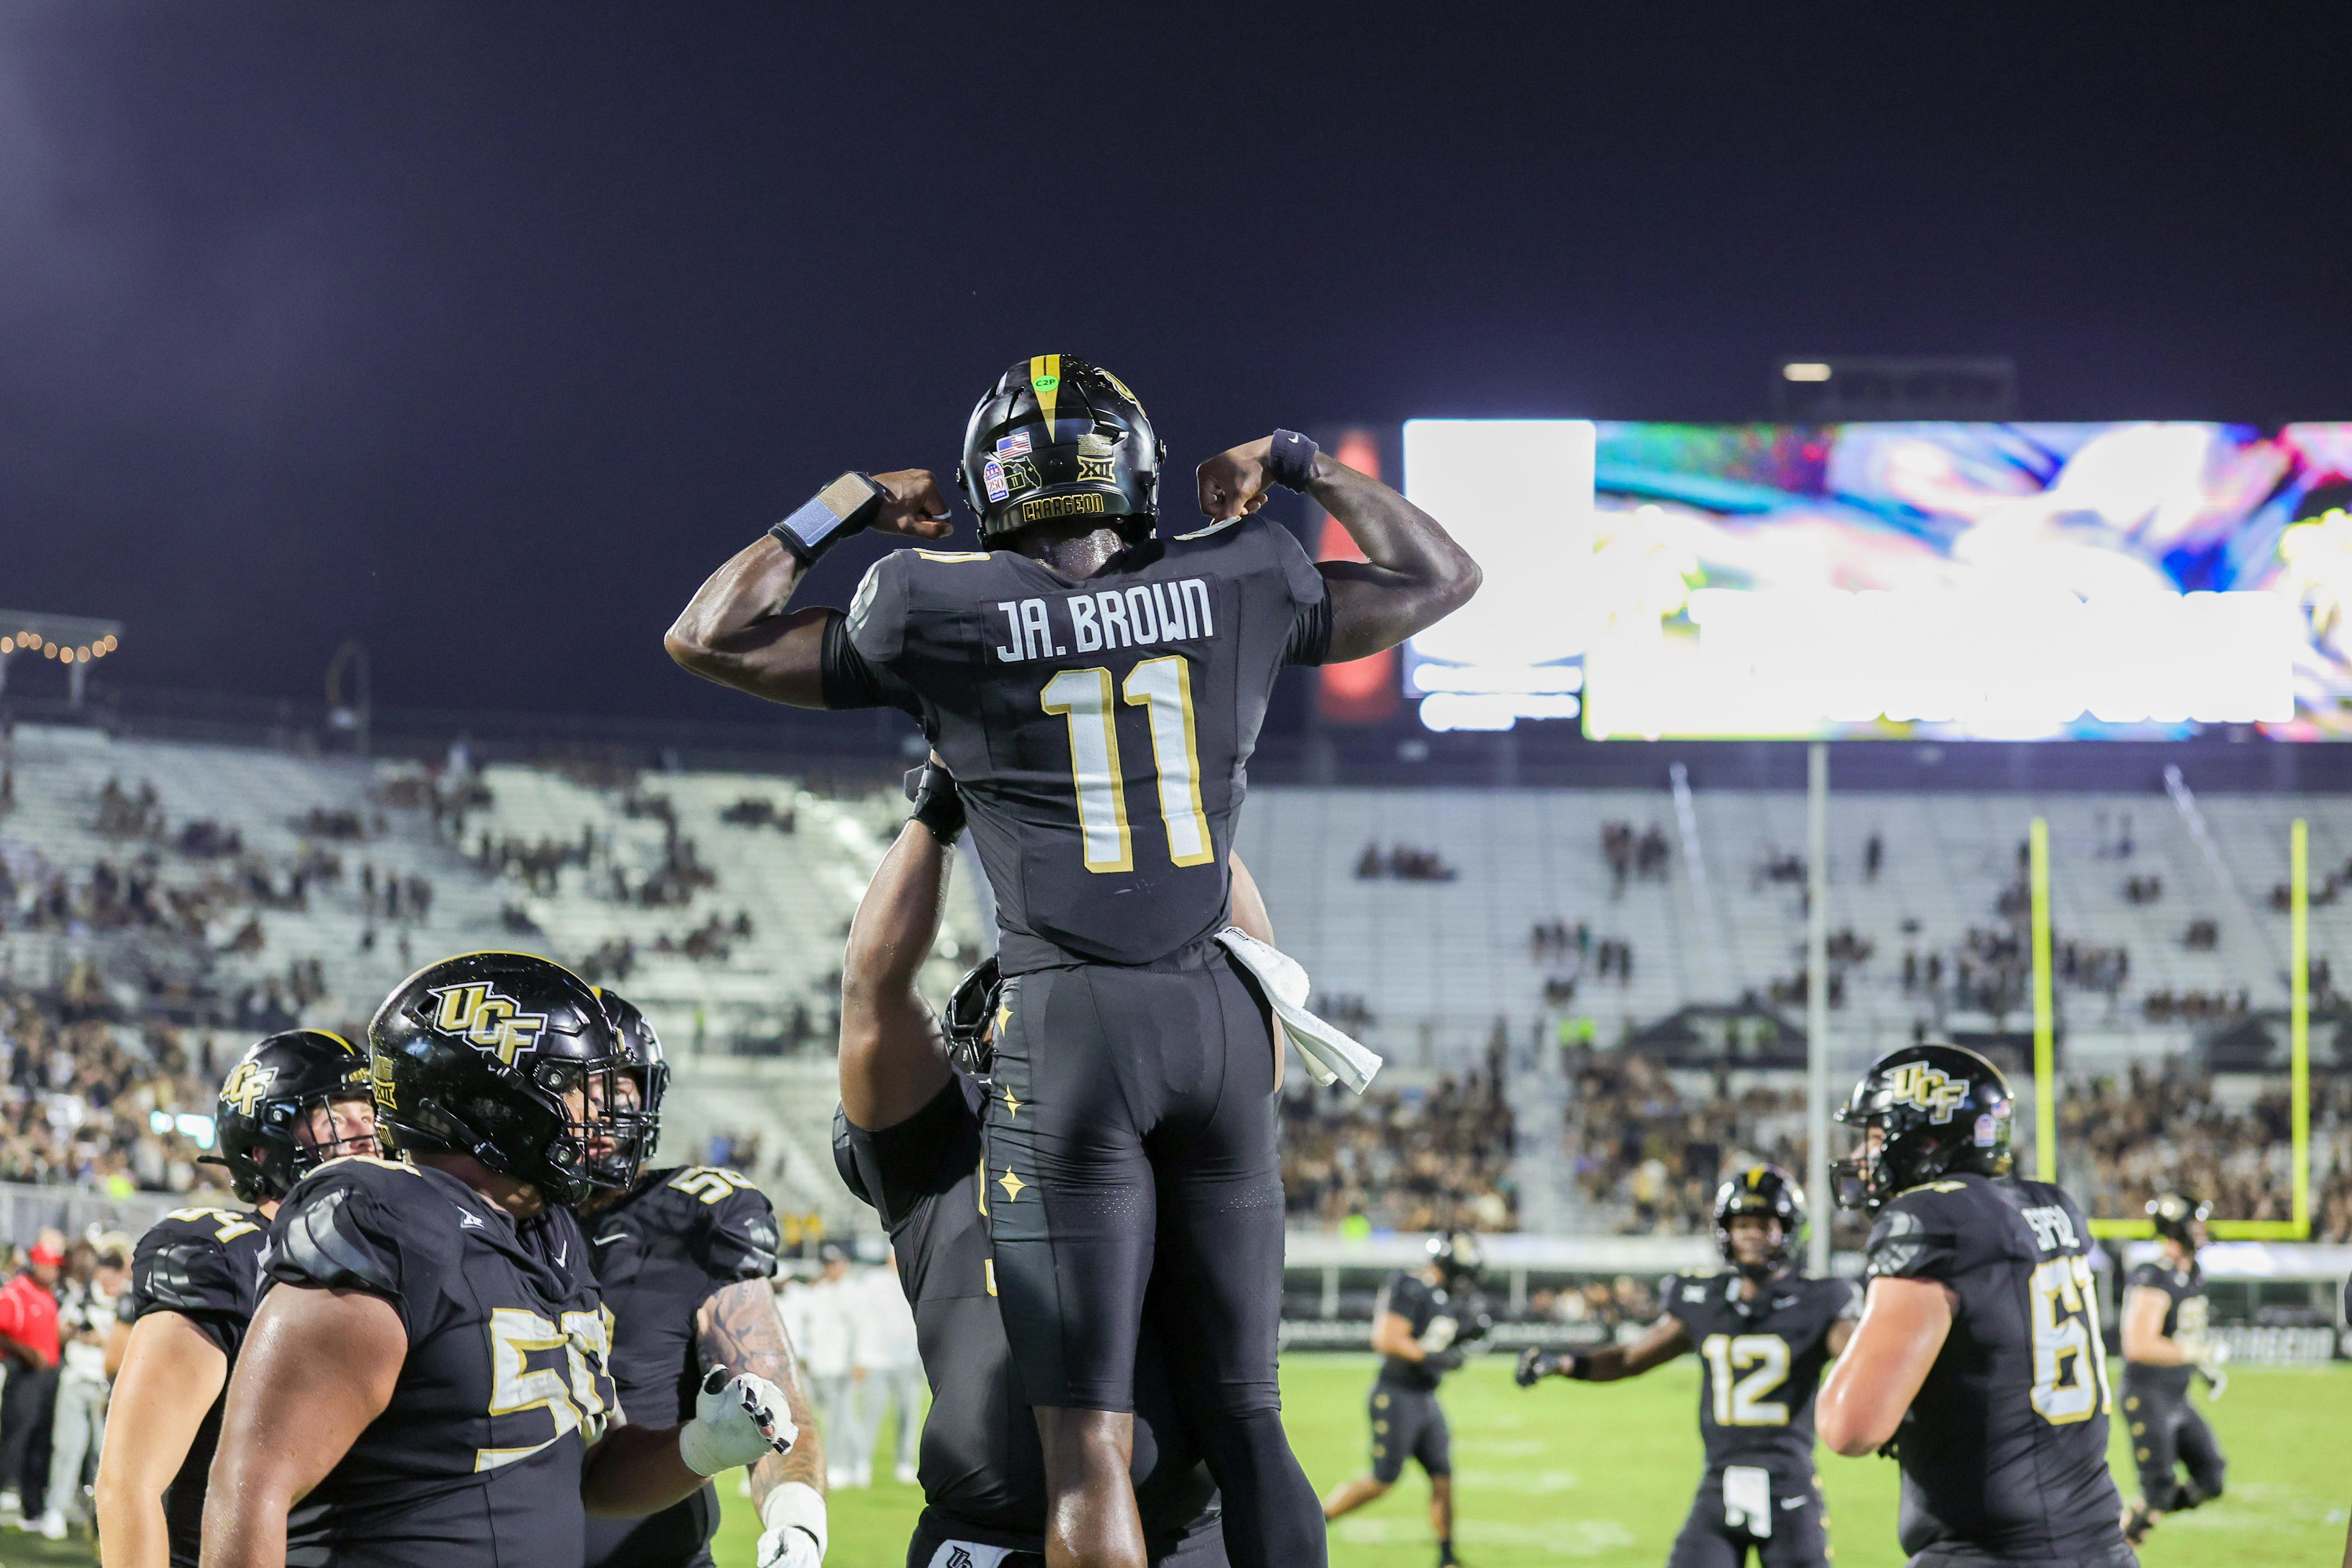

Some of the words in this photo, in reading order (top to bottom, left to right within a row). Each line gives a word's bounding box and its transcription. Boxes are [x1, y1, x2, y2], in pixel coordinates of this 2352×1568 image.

[987, 477, 1004, 492] 250
[1023, 493, 1104, 522] CHARGEON
[996, 598, 1066, 663] JA.
[1067, 578, 1215, 654] BROWN
[1040, 655, 1215, 873] 11
[427, 980, 548, 1070] UCF
[1882, 1060, 1970, 1125] UCF
[1702, 1334, 1789, 1427] 12
[2028, 1254, 2112, 1426] 61
